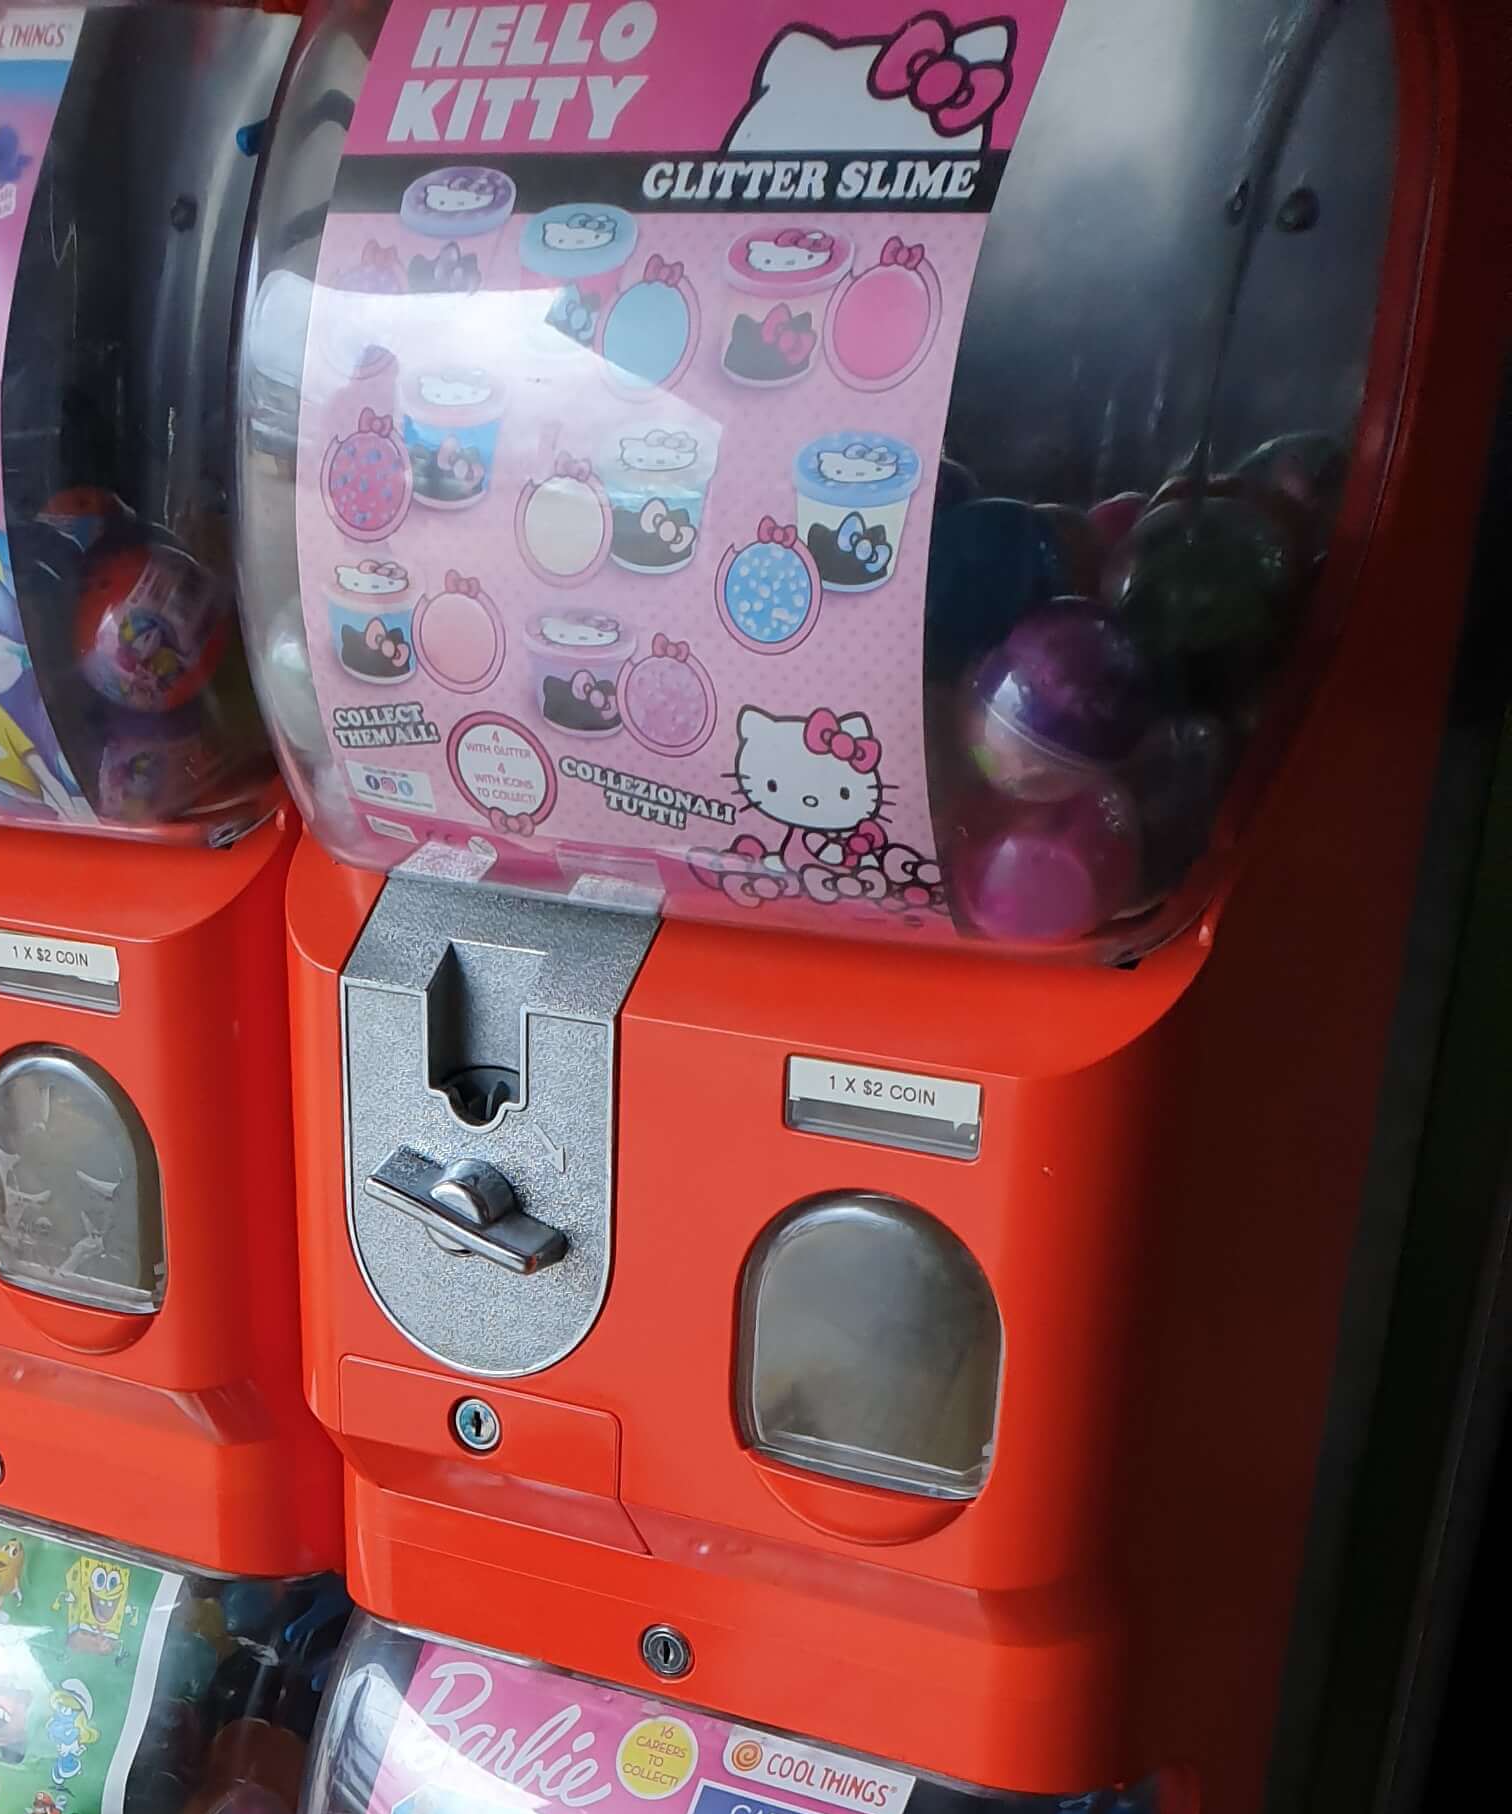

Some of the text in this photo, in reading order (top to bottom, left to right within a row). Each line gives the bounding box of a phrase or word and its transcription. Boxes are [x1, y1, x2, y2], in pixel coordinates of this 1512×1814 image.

[10, 23, 66, 48] THINGS
[411, 1, 658, 69] HELLO
[387, 75, 649, 143] KITTY
[642, 159, 981, 201] GLITTER SLIME
[334, 702, 423, 727] COLLECT
[333, 722, 441, 748] THEM ALL!
[464, 742, 533, 759] WITH GLITTER
[474, 773, 535, 791] WITH ICONS
[476, 786, 491, 799] TO
[559, 756, 737, 825] COLLEZIONALI
[604, 790, 687, 830] TUTTI!
[12, 945, 89, 968] 1 X $2 COIN
[828, 1074, 936, 1107] 1 X $2 COIN
[421, 1661, 613, 1808] Barbie
[659, 1724, 675, 1740] 16
[634, 1735, 688, 1760] CAREERS
[648, 1753, 664, 1769] TO
[621, 1762, 680, 1787] COLLECT!
[765, 1752, 890, 1808] COOL THINGS
